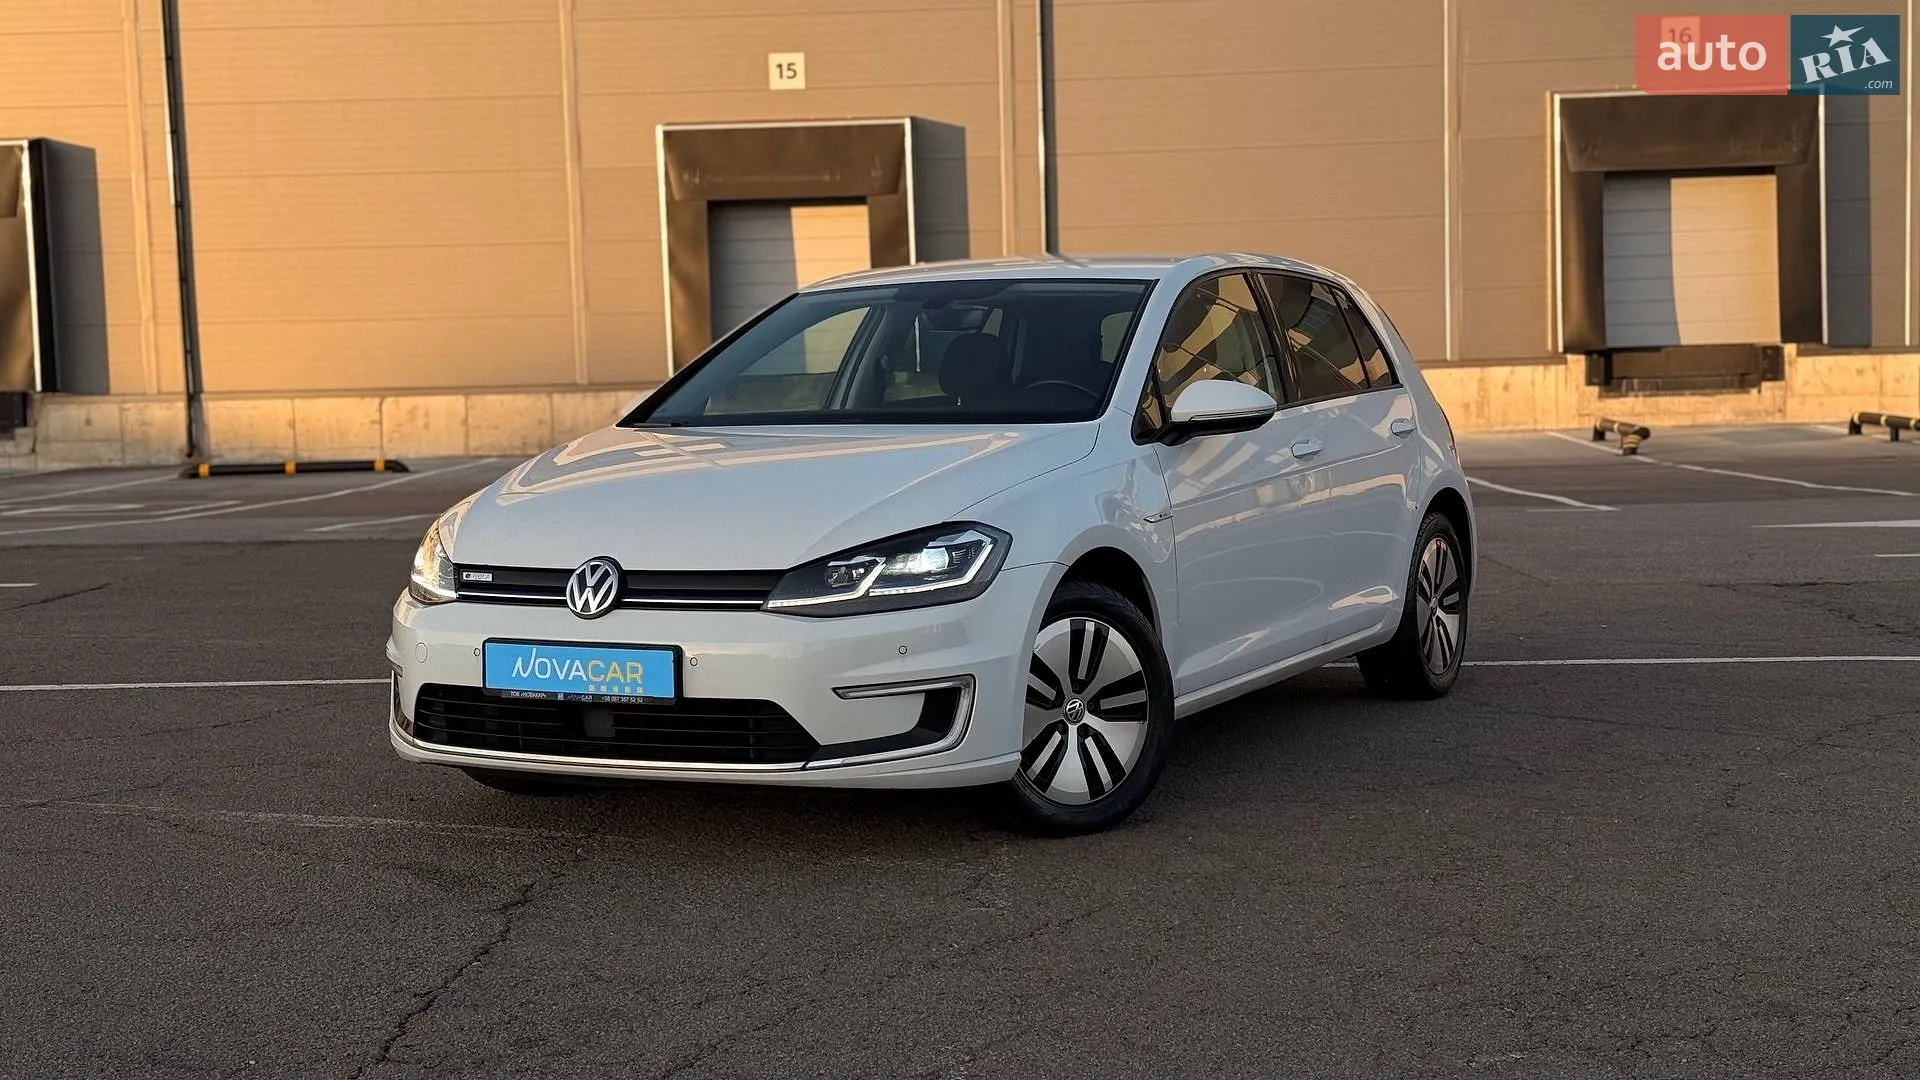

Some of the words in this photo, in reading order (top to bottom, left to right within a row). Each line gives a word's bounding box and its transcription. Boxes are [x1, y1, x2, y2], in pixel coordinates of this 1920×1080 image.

[776, 62, 797, 80] 15
[567, 560, 618, 615] VW
[511, 648, 644, 684] NOVACAR
